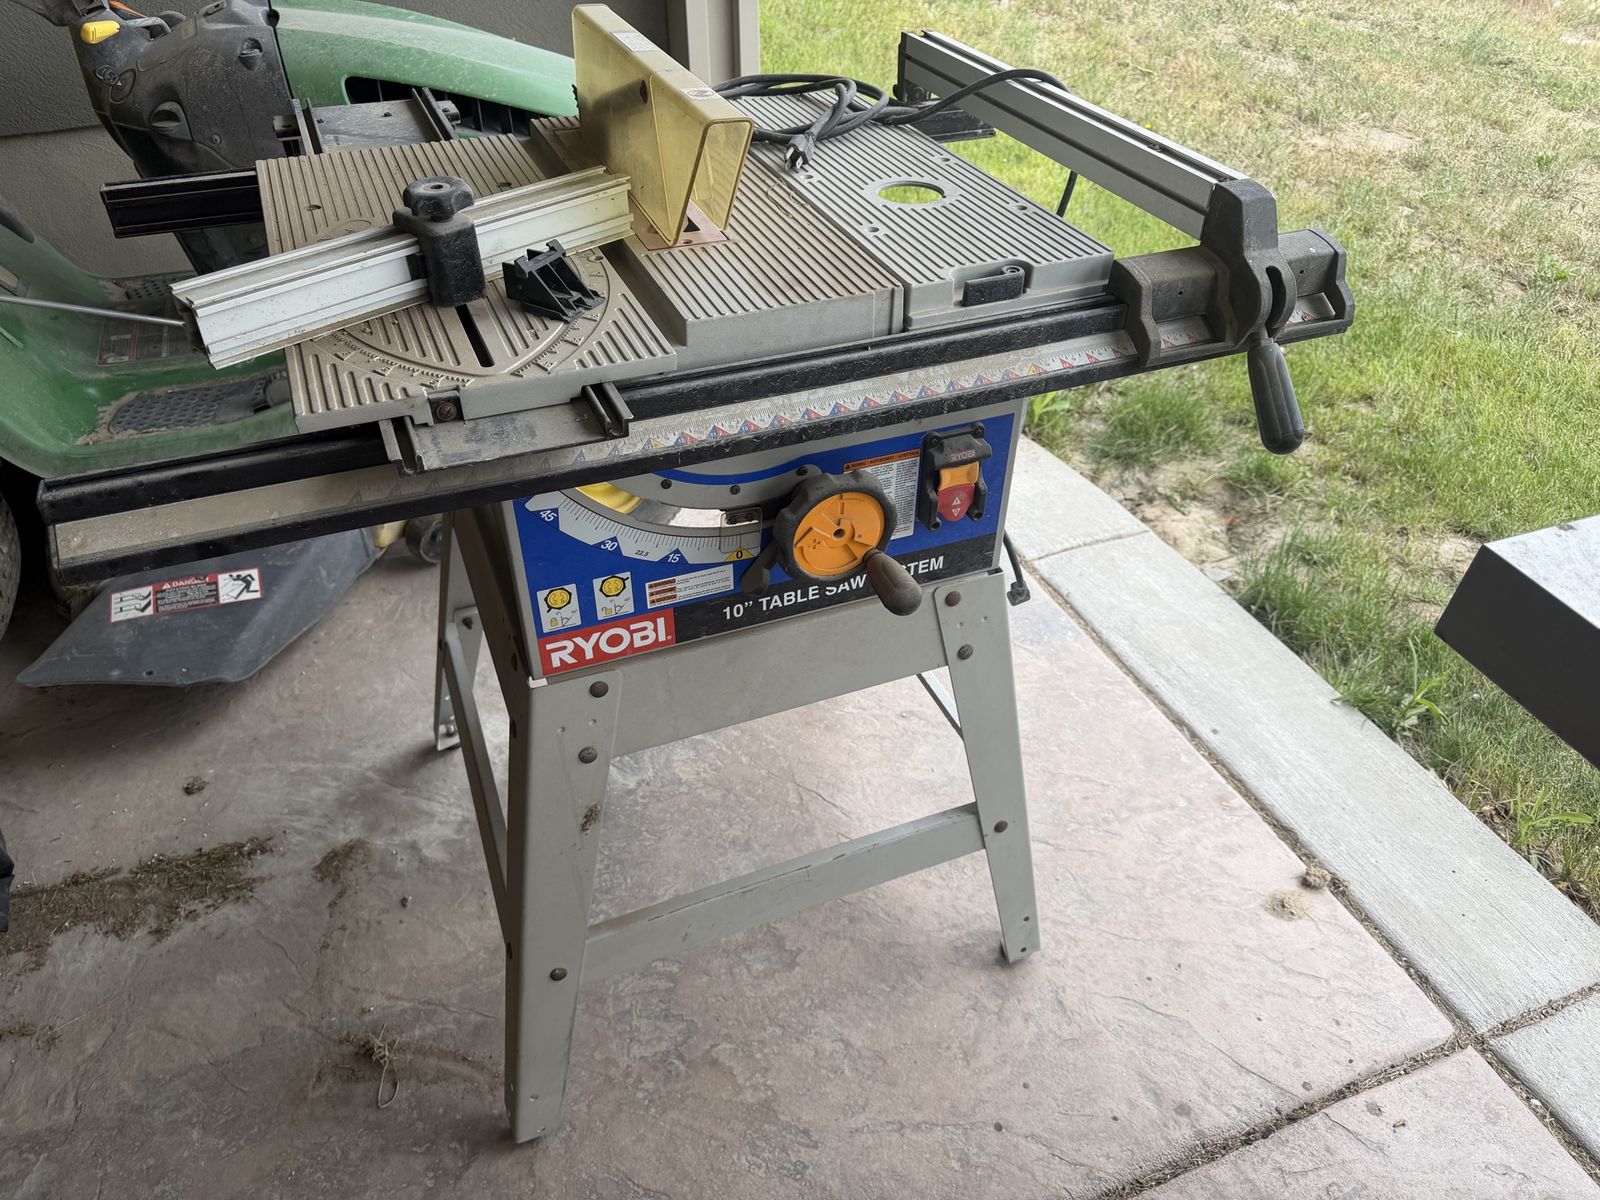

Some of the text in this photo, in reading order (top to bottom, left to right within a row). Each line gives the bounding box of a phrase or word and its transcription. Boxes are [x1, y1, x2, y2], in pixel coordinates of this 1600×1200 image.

[949, 450, 976, 462] RYOBI
[538, 509, 557, 522] 45
[600, 540, 618, 551] 30
[634, 548, 650, 557] 22.5
[667, 552, 681, 563] 15
[735, 550, 743, 559] 0
[759, 586, 820, 611] TABLE
[824, 573, 868, 597] SAW
[901, 555, 944, 577] TEM
[545, 616, 667, 669] RYOBI
